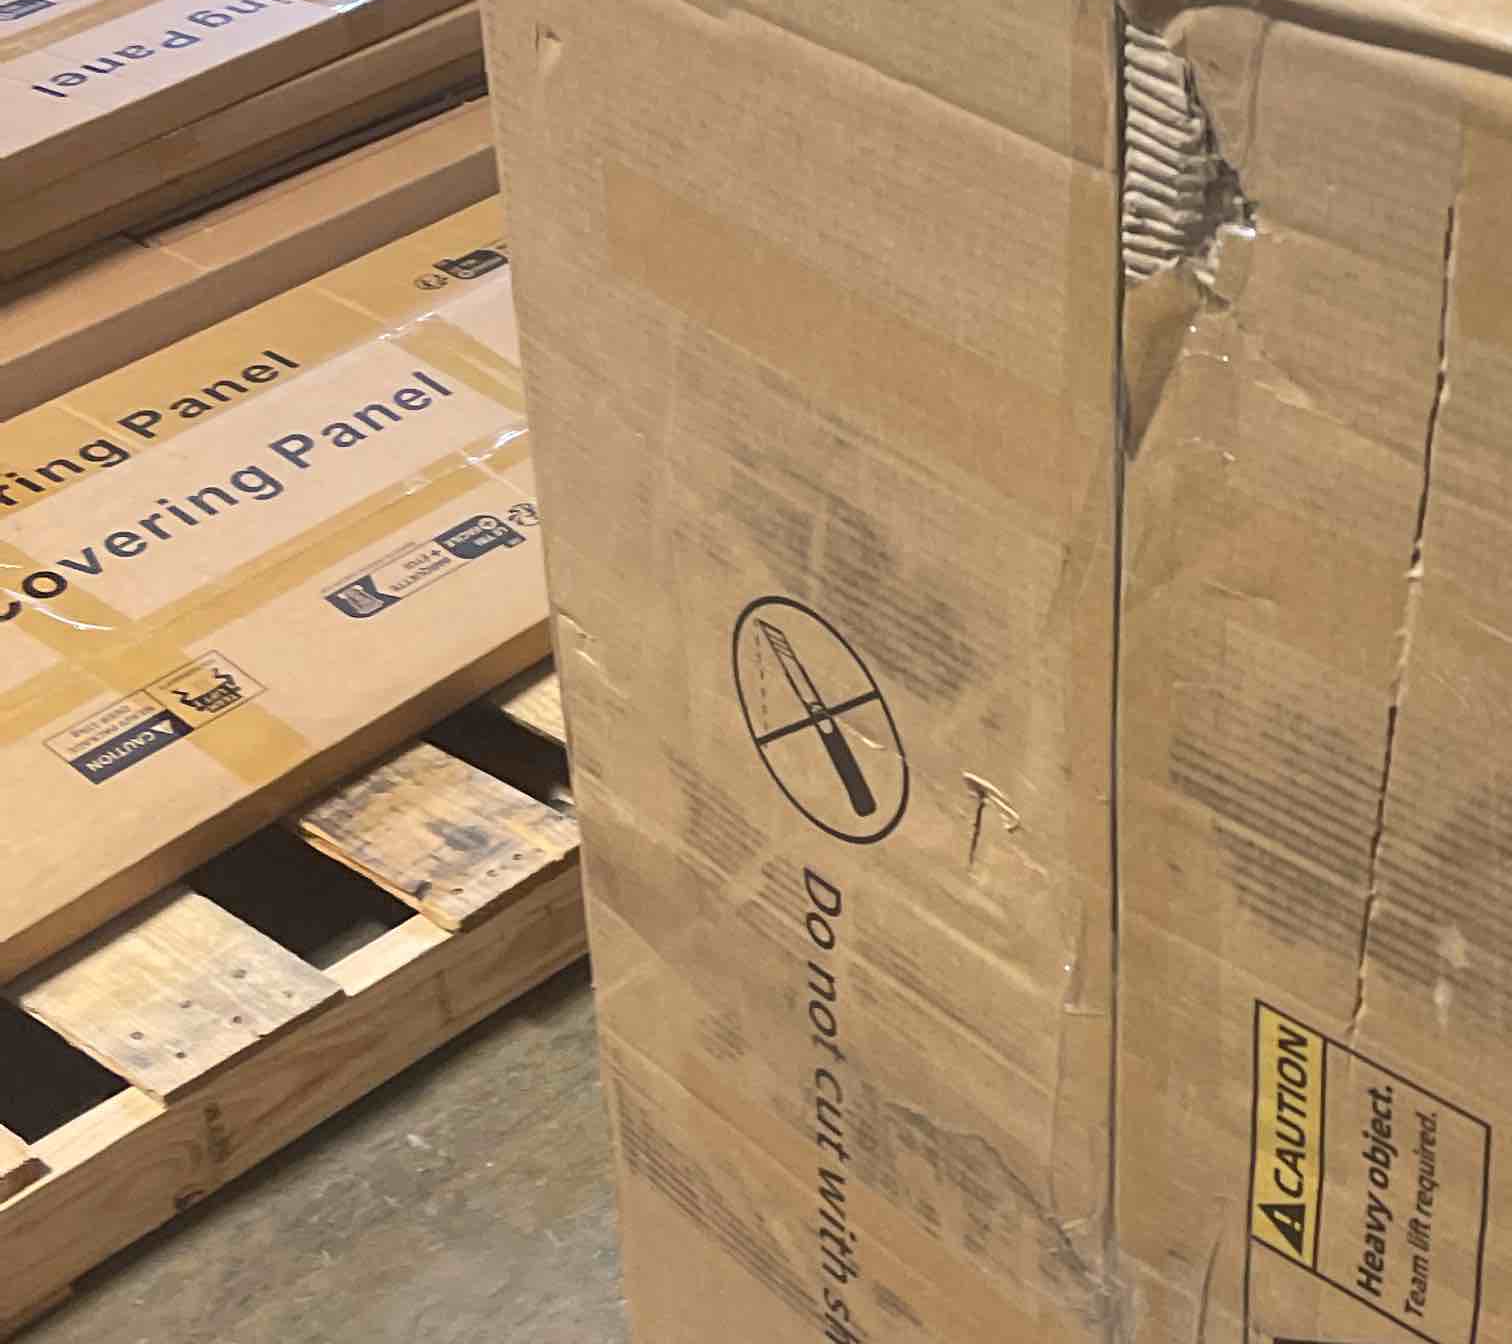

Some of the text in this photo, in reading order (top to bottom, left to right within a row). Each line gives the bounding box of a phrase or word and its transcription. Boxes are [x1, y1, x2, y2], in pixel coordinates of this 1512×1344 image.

[33, 28, 199, 98] Panel
[119, 350, 301, 440] Panel
[270, 369, 455, 470] Panel
[84, 730, 157, 772] CAUTION
[804, 866, 842, 950] Do
[808, 959, 845, 1062] not
[814, 1067, 850, 1163] cut
[1273, 1023, 1309, 1200] CAUTION
[817, 1168, 858, 1285] with
[1356, 1085, 1399, 1299] Heavy object.
[1403, 1111, 1440, 1318] Team lift required.
